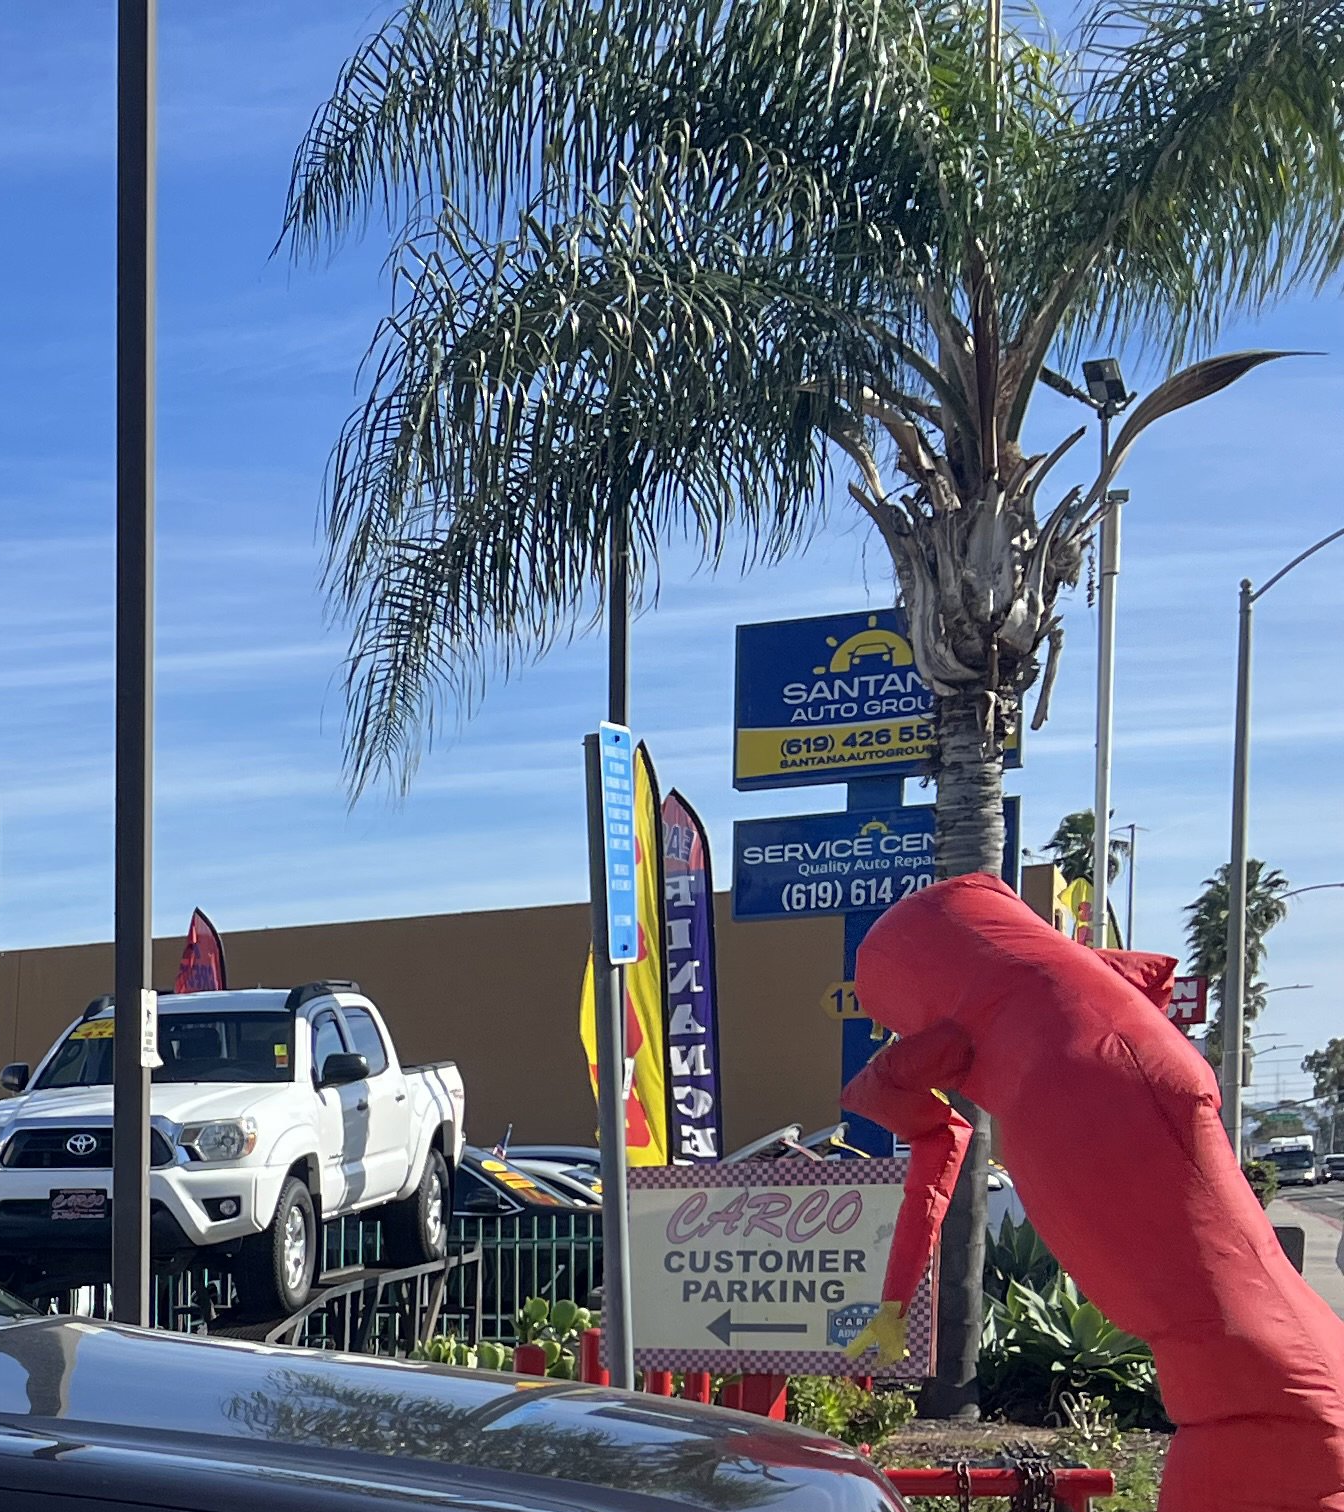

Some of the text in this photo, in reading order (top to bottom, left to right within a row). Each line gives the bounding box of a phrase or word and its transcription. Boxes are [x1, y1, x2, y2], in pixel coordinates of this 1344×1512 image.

[790, 702, 857, 723] AUTO
[781, 724, 936, 759] (619) 426 55
[780, 745, 934, 768] SANTANAAUTOGROU
[743, 837, 873, 864] SERVICE
[798, 860, 850, 877] Quality
[854, 858, 890, 871] Auto
[781, 879, 843, 911] (619)
[850, 876, 893, 905] 614
[665, 1190, 863, 1245] CARCO
[663, 1249, 867, 1273] CUSTOMER
[683, 1279, 845, 1303] PARKING
